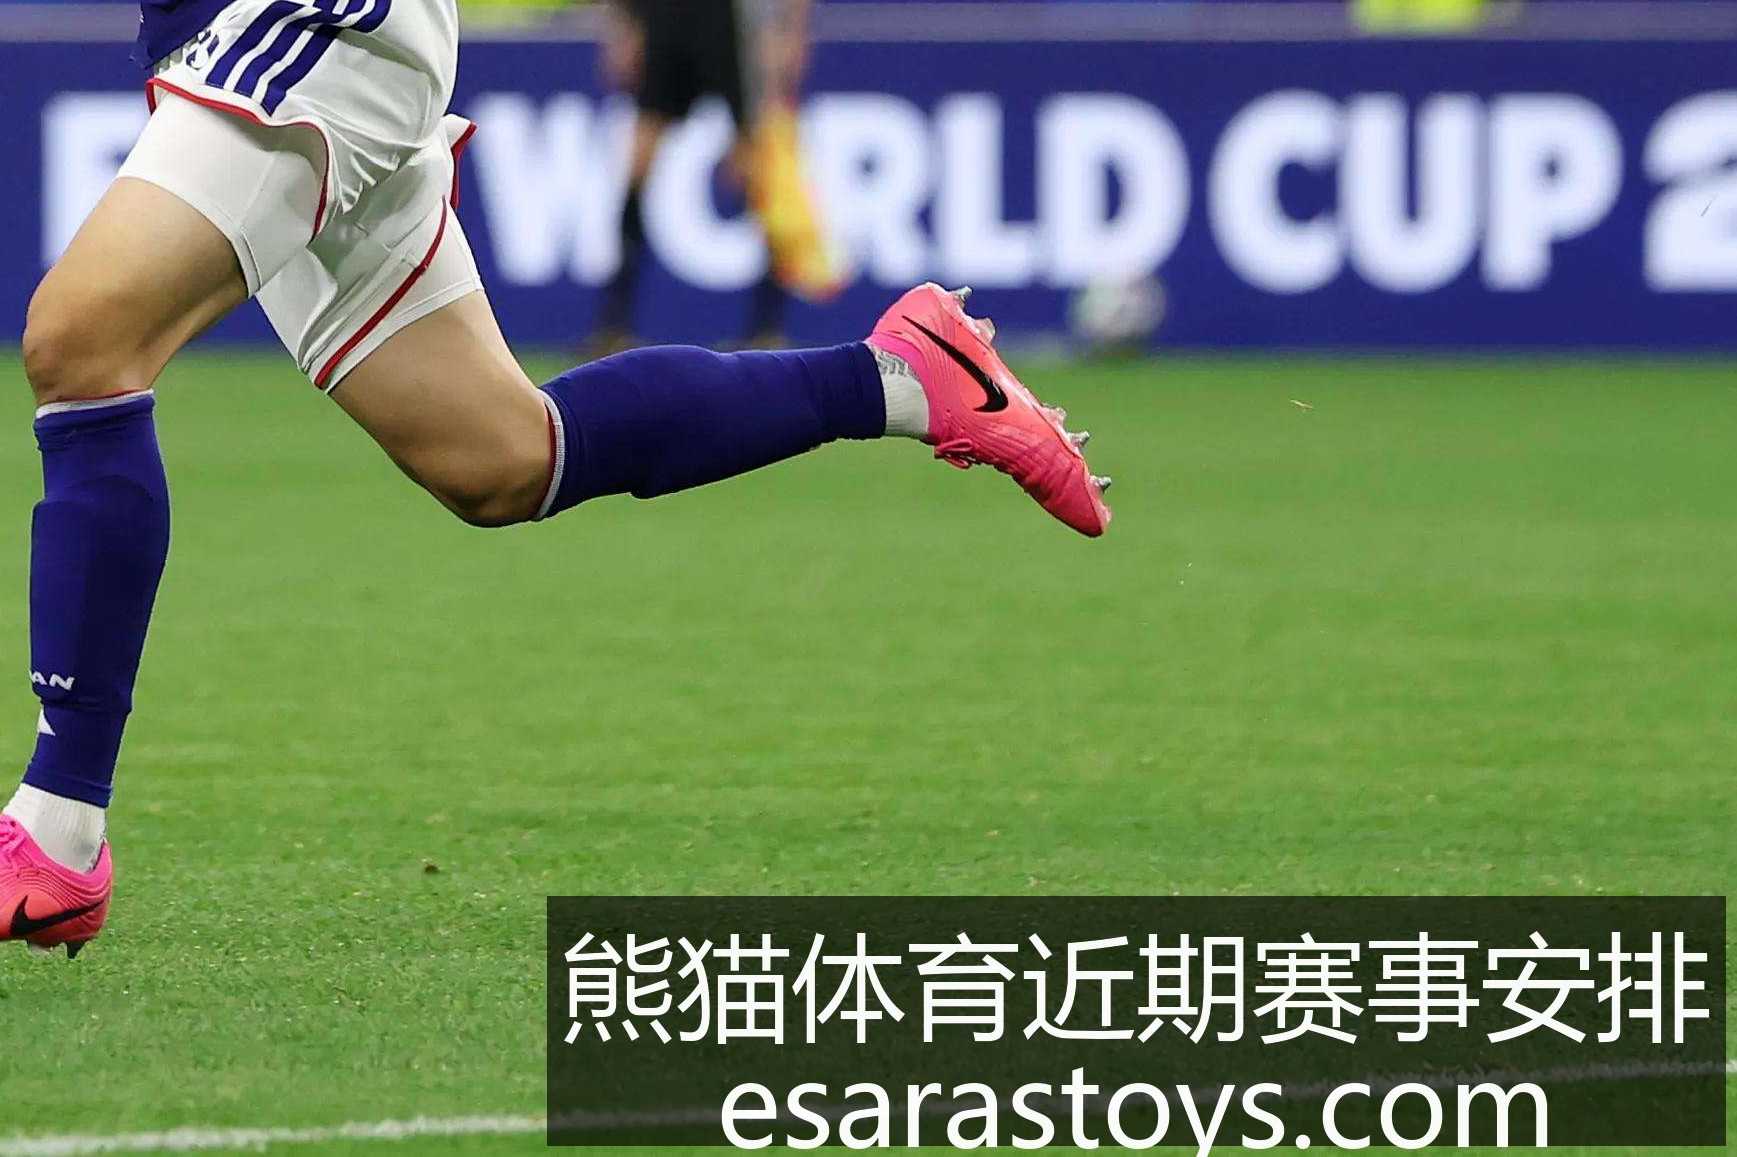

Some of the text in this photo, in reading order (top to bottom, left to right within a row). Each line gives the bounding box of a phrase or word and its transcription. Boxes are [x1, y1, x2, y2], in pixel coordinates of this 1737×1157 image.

[470, 91, 1189, 291] WORLD
[1210, 90, 1622, 292] CUP
[29, 670, 75, 690] AN
